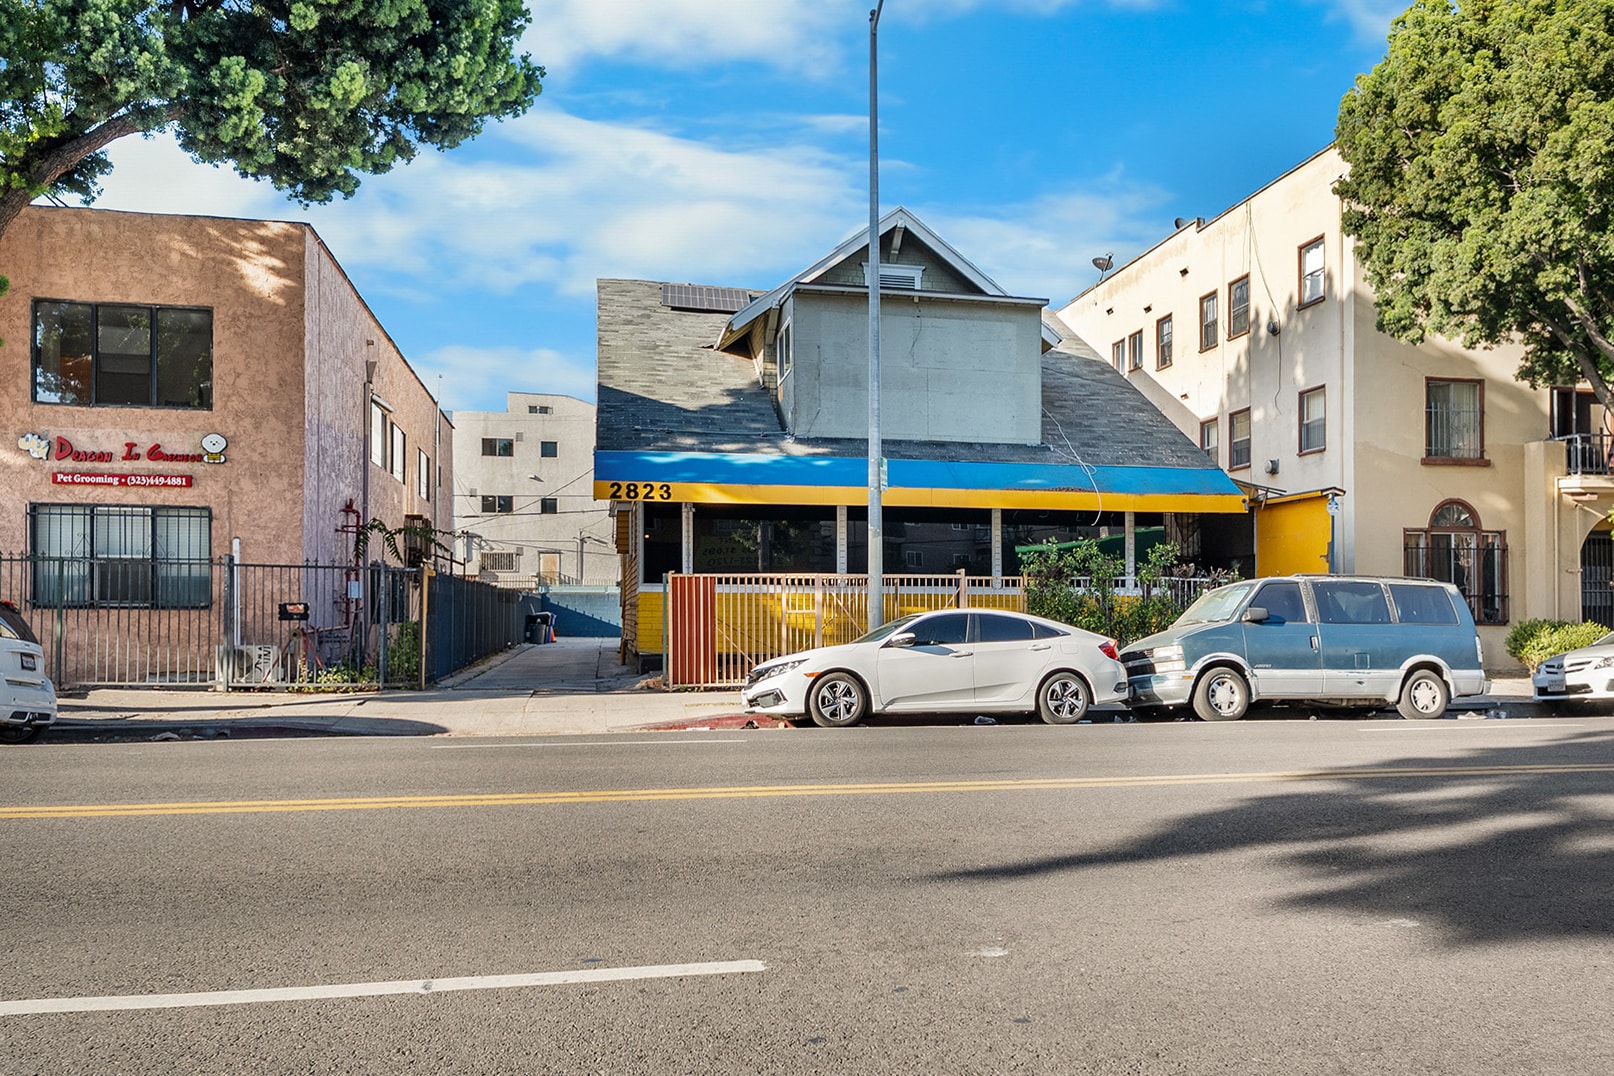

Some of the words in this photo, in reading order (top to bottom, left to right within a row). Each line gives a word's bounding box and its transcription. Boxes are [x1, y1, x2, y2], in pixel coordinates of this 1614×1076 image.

[55, 436, 113, 462] DRAGON
[121, 442, 141, 461] IN
[57, 474, 72, 483] Pet
[74, 474, 119, 485] Grooming
[609, 482, 672, 500] 2823
